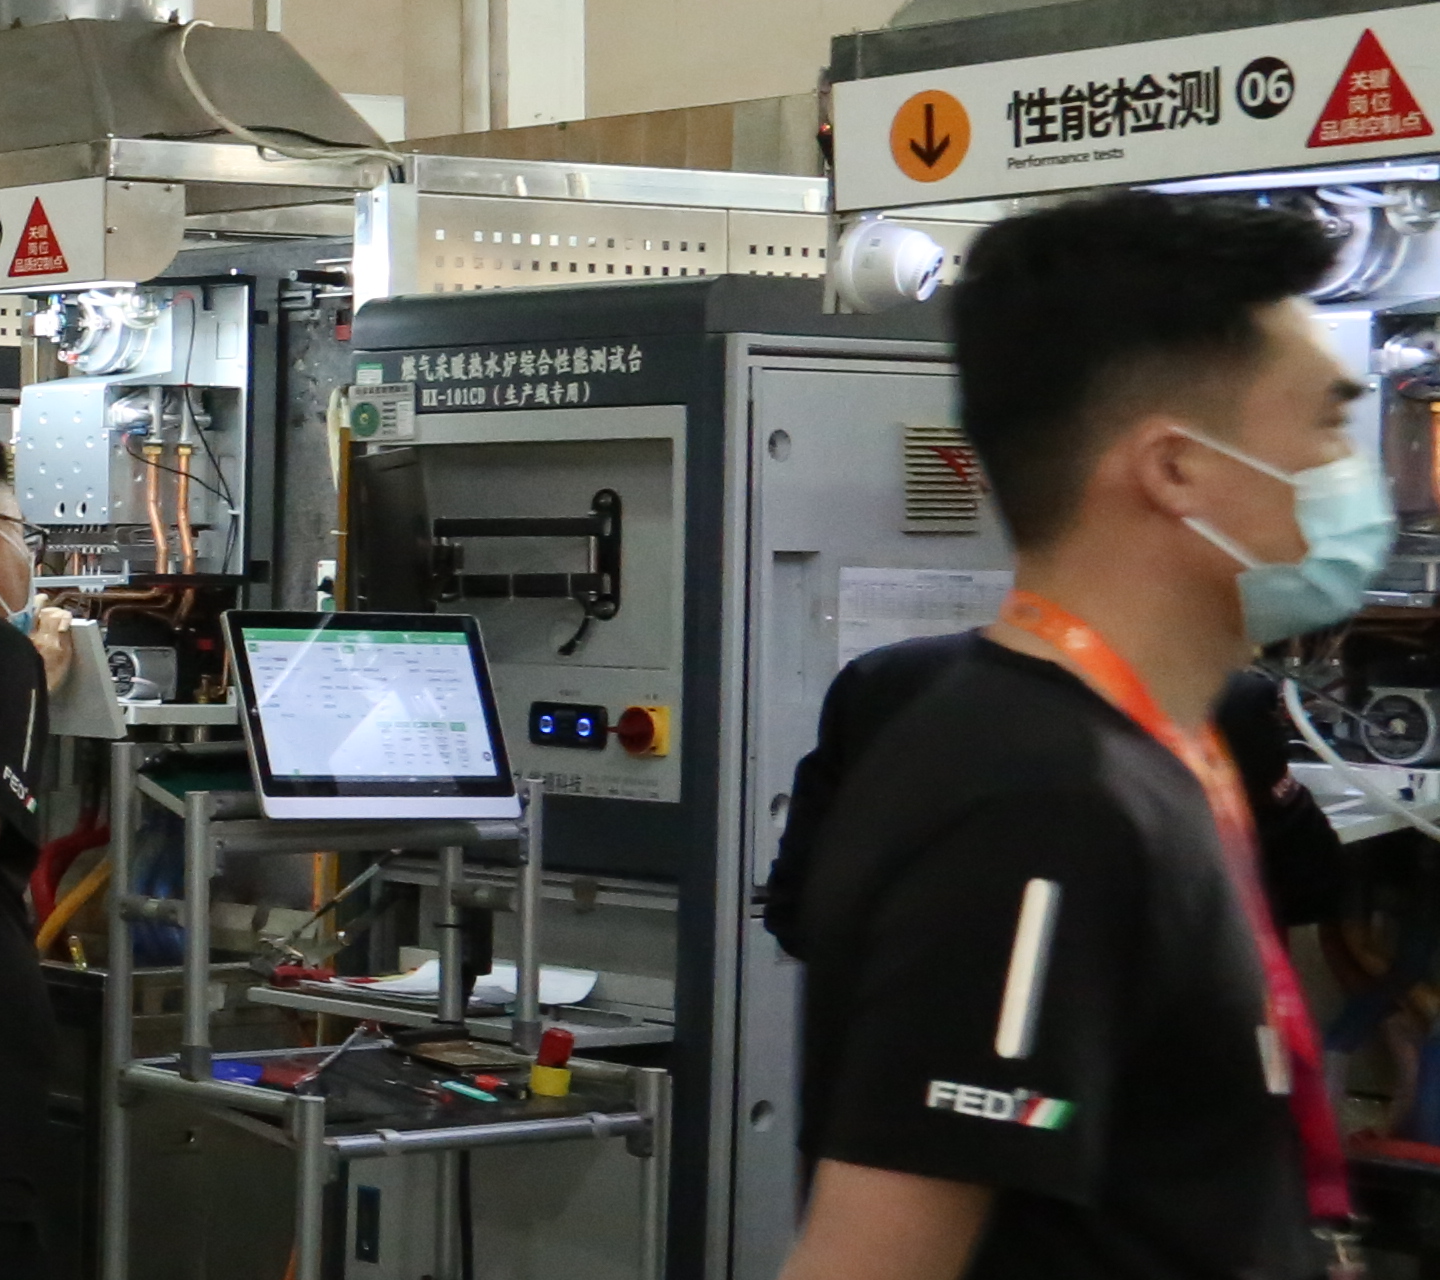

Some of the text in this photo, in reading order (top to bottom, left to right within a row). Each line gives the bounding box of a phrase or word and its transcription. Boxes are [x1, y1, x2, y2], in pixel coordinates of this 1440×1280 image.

[1007, 66, 1290, 148] 性能检测 06
[1347, 92, 1392, 112] 岗位
[1319, 112, 1422, 140] 品质控制点
[1008, 148, 1124, 170] Performance tests
